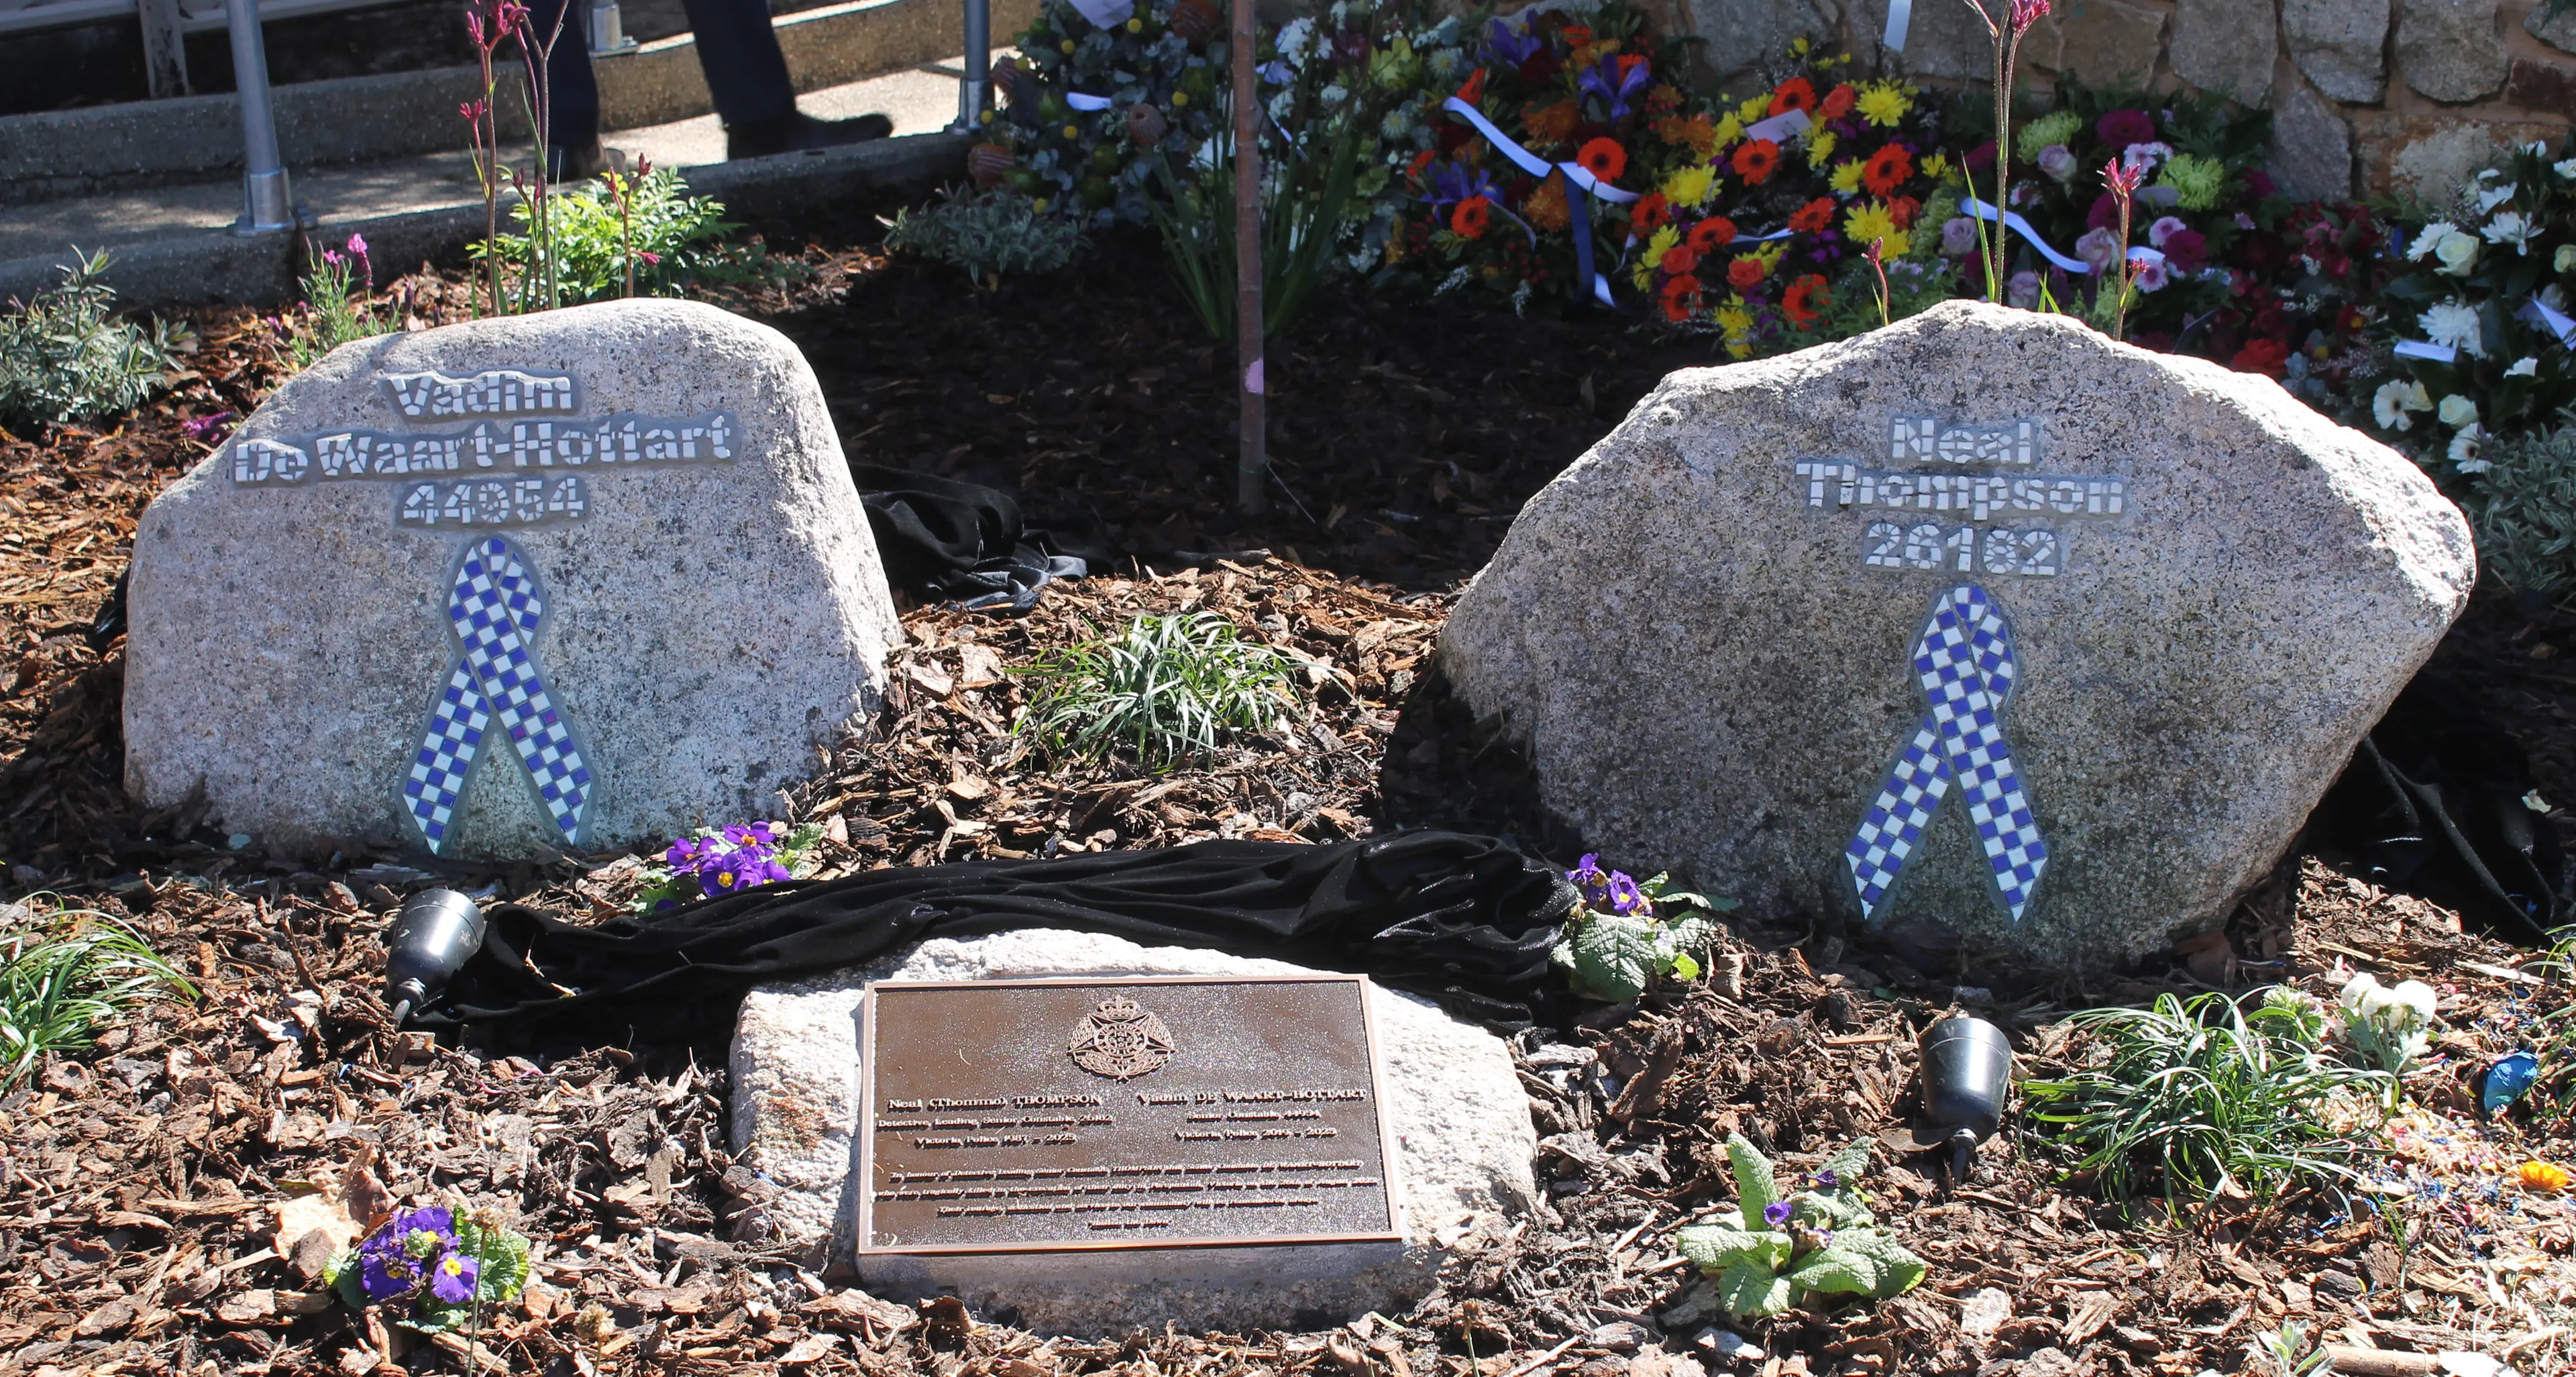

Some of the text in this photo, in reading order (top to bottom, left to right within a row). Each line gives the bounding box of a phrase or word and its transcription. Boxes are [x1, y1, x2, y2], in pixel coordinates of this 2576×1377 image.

[387, 373, 571, 416] Vadim
[235, 415, 731, 482] De Waart-Hottart
[1892, 418, 2031, 464] Neal
[402, 477, 584, 525] 44954
[1795, 463, 2123, 520] Thompson
[1866, 522, 2056, 575] 26182
[1098, 1024, 1142, 1036] VICTORIA
[1104, 1044, 1140, 1055] POLICE
[888, 1095, 1102, 1110] Neal (Thommo) THOMPSON
[1138, 1089, 1366, 1104] Vadim DE WAART-HOTTART
[877, 1119, 929, 1129] Detective
[982, 1115, 1017, 1125] Senior
[915, 1136, 962, 1146] Victoria
[965, 1135, 999, 1144] Police
